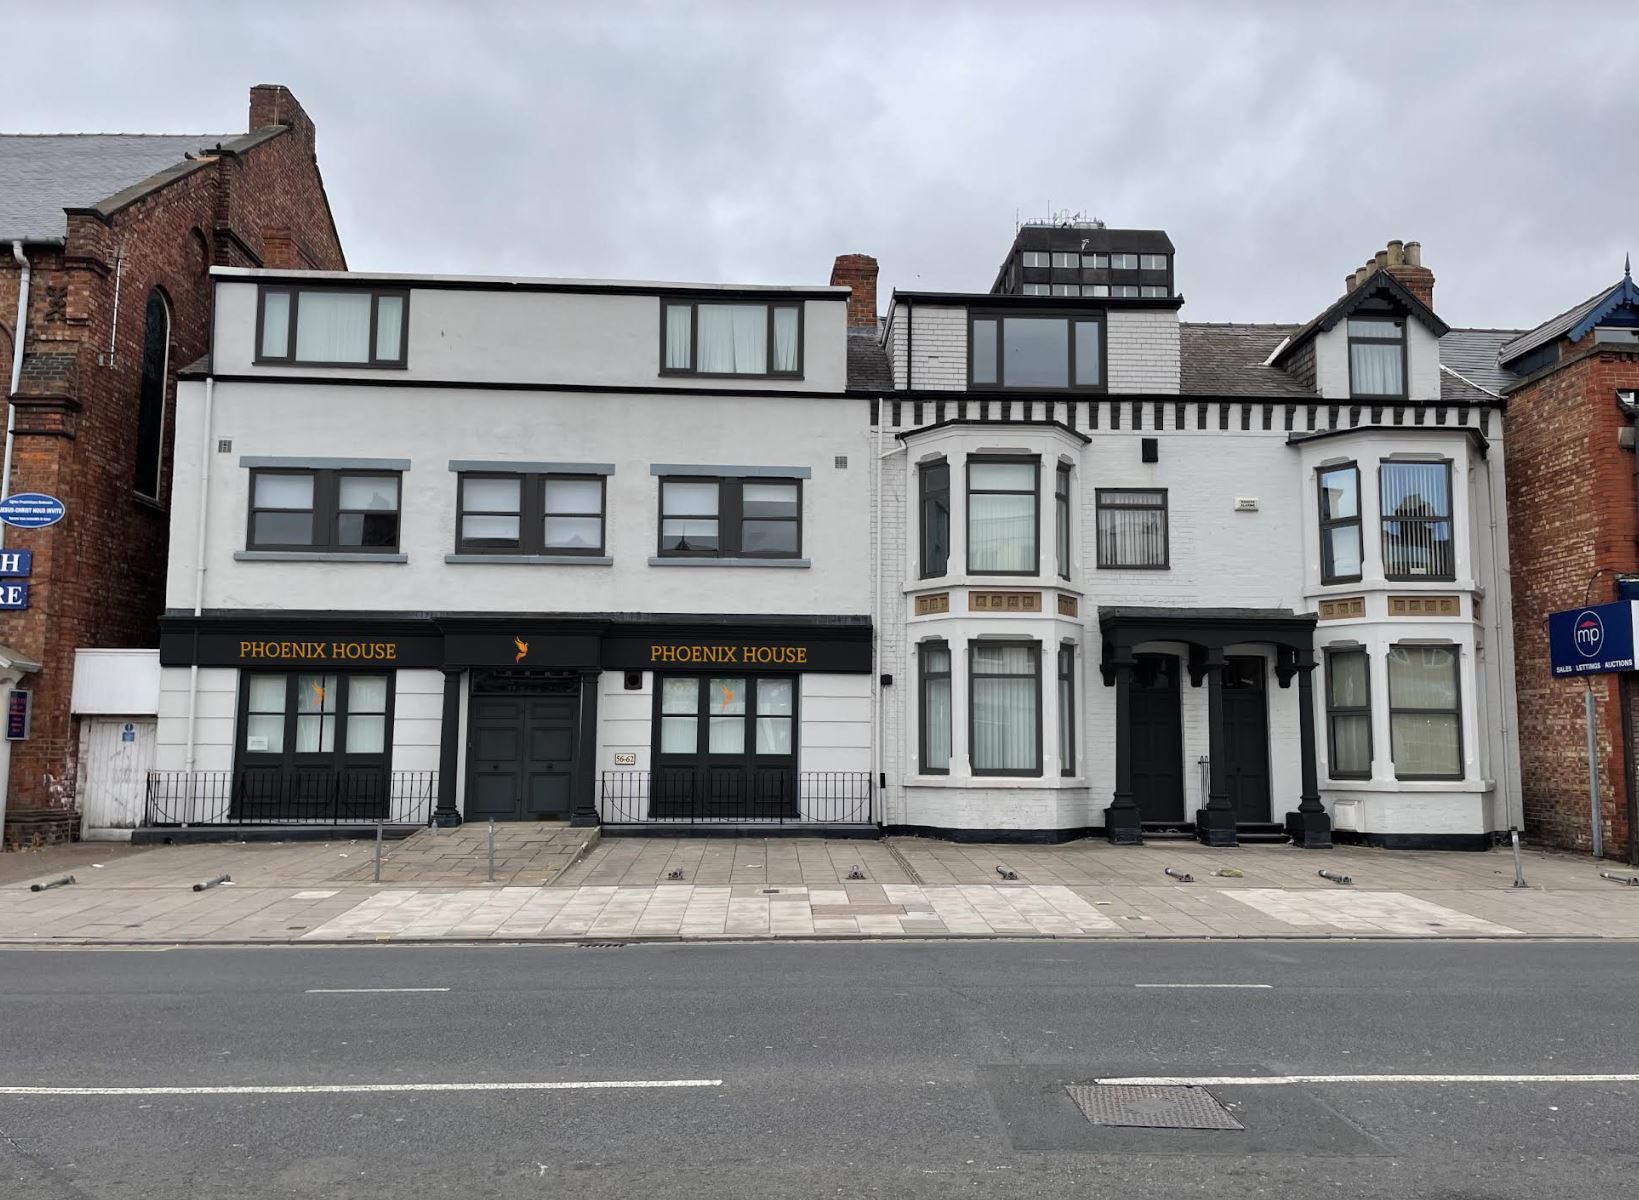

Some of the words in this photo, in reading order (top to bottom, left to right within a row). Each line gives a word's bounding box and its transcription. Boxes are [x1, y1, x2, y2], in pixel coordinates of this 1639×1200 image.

[1577, 627, 1600, 646] mp
[239, 641, 327, 658] PHOENIX
[332, 643, 397, 659] HOUSE
[650, 645, 738, 662] PHOENIX
[742, 647, 808, 663] HOUSE
[1556, 665, 1573, 673] SALES
[1576, 663, 1601, 671] LETTINGS
[1604, 659, 1633, 668] AUCTIONS
[616, 755, 634, 763] 56-62
